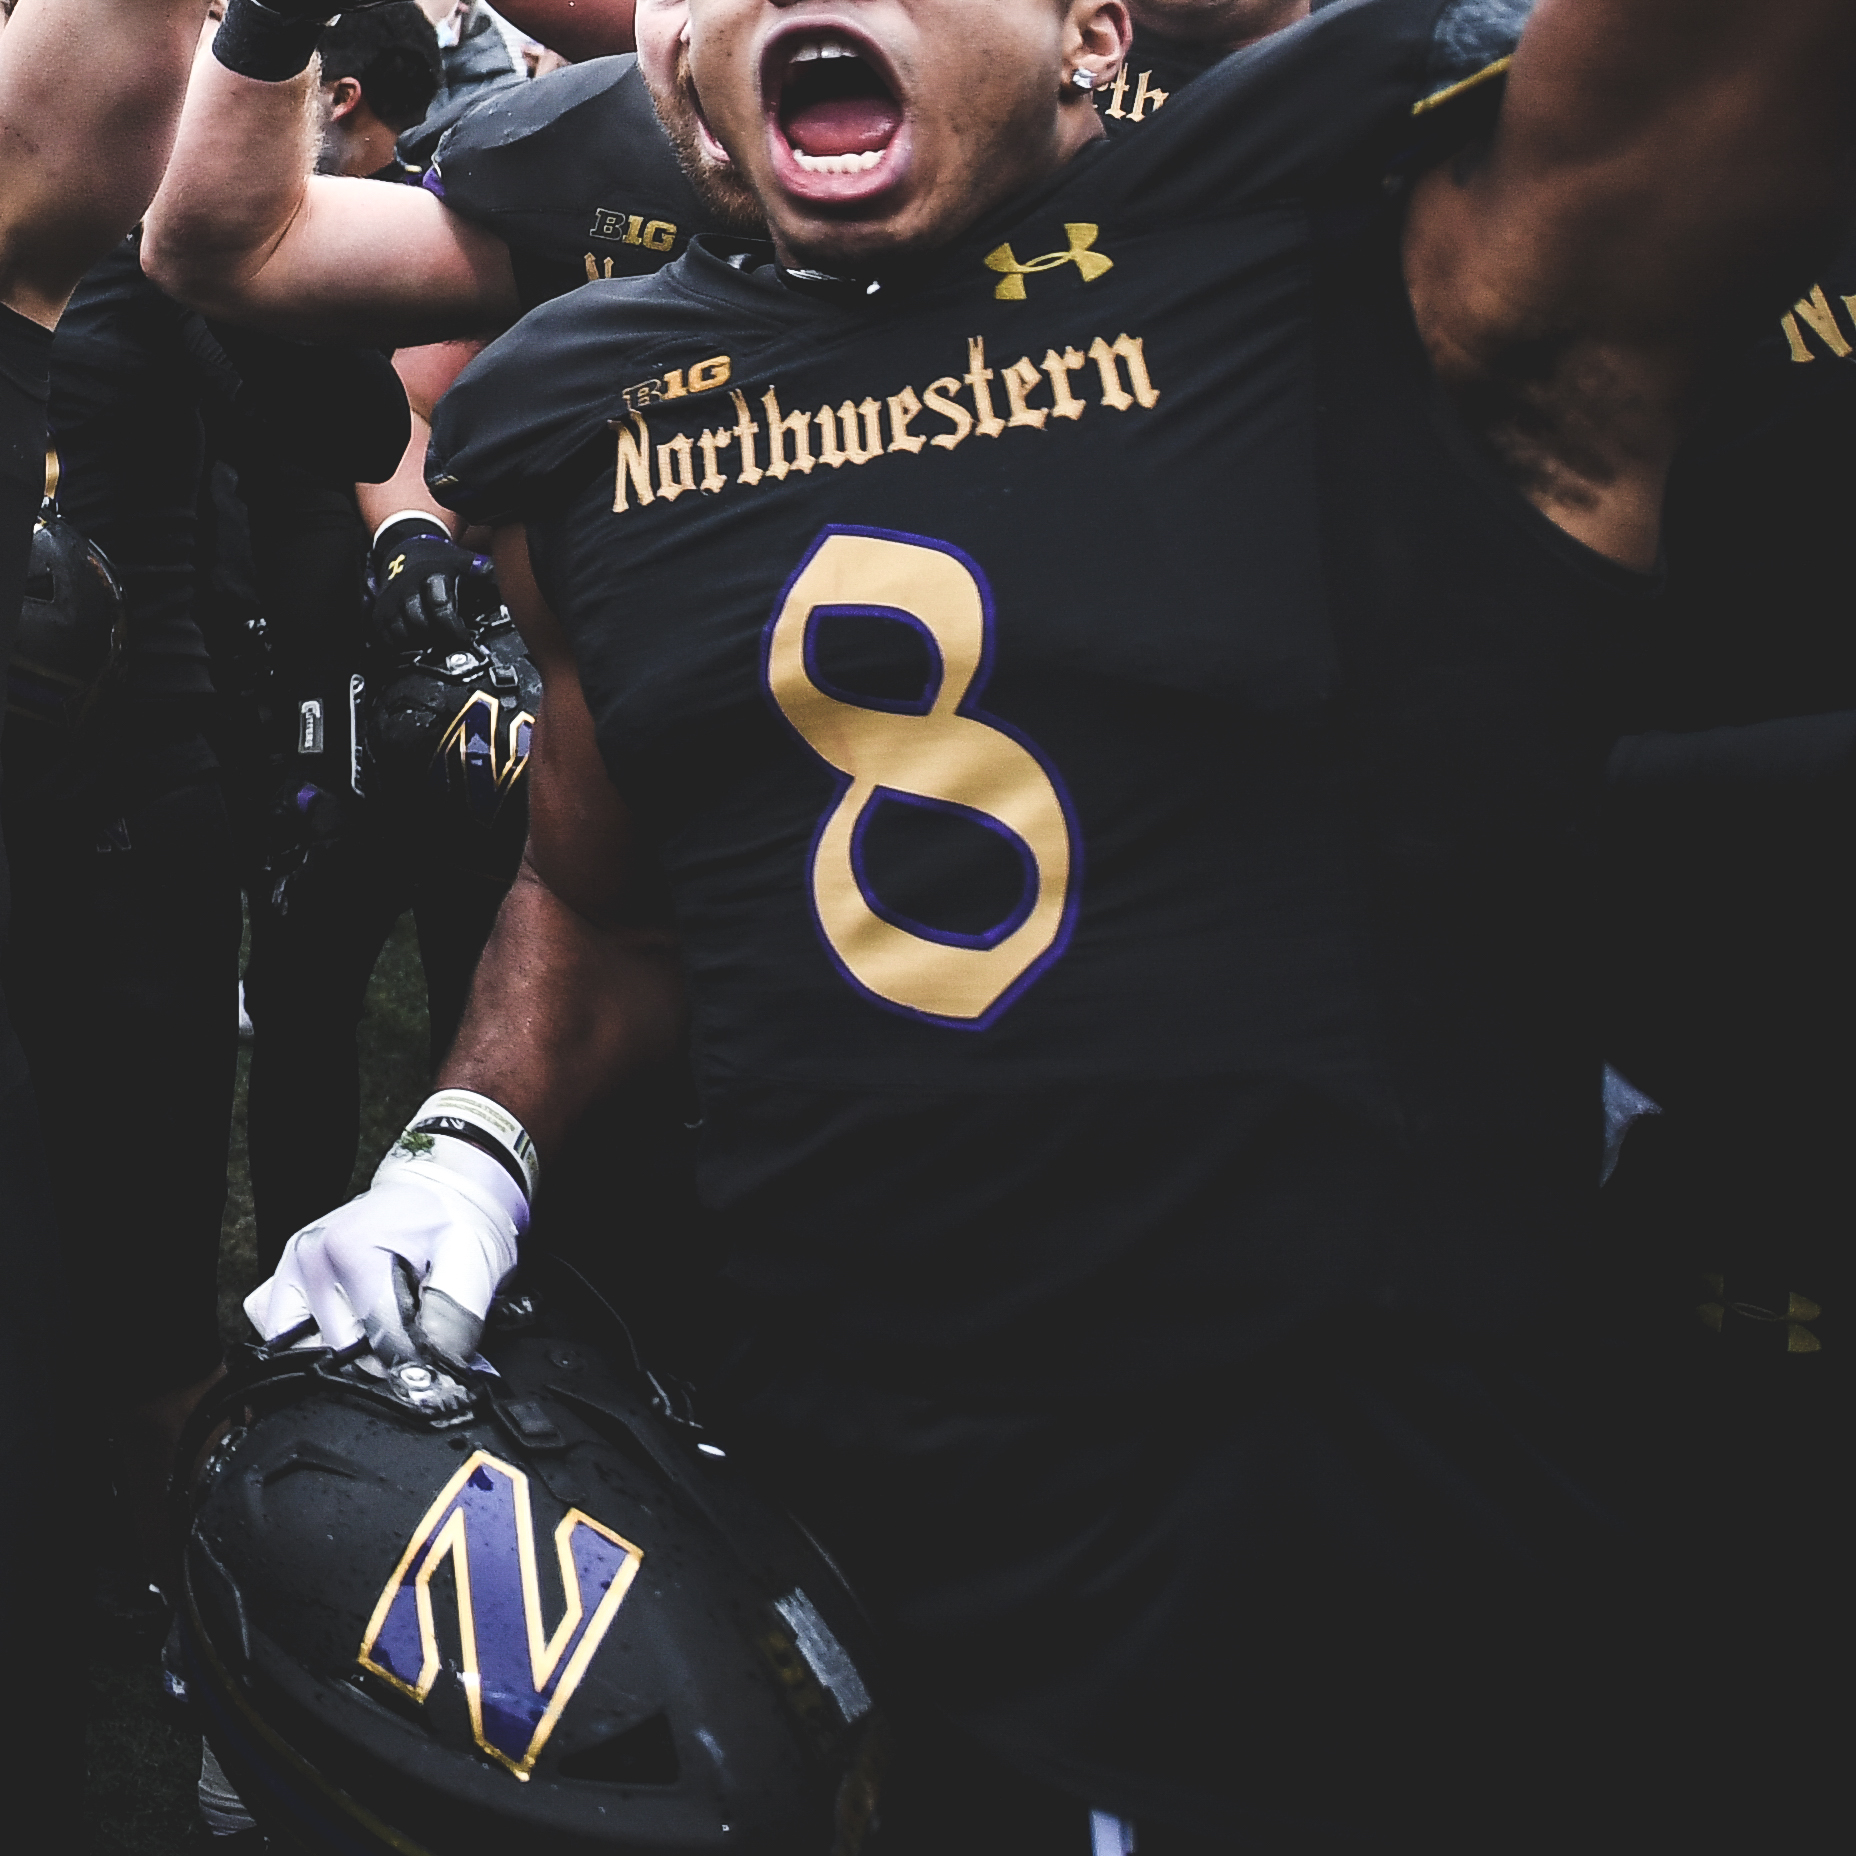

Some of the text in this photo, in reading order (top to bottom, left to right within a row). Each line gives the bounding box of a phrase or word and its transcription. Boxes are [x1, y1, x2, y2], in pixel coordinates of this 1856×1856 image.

[589, 208, 677, 253] B1G
[609, 332, 1161, 514] Northwestern
[623, 355, 731, 411] B1G
[760, 523, 1081, 1031] 8
[358, 1450, 645, 1782] N
